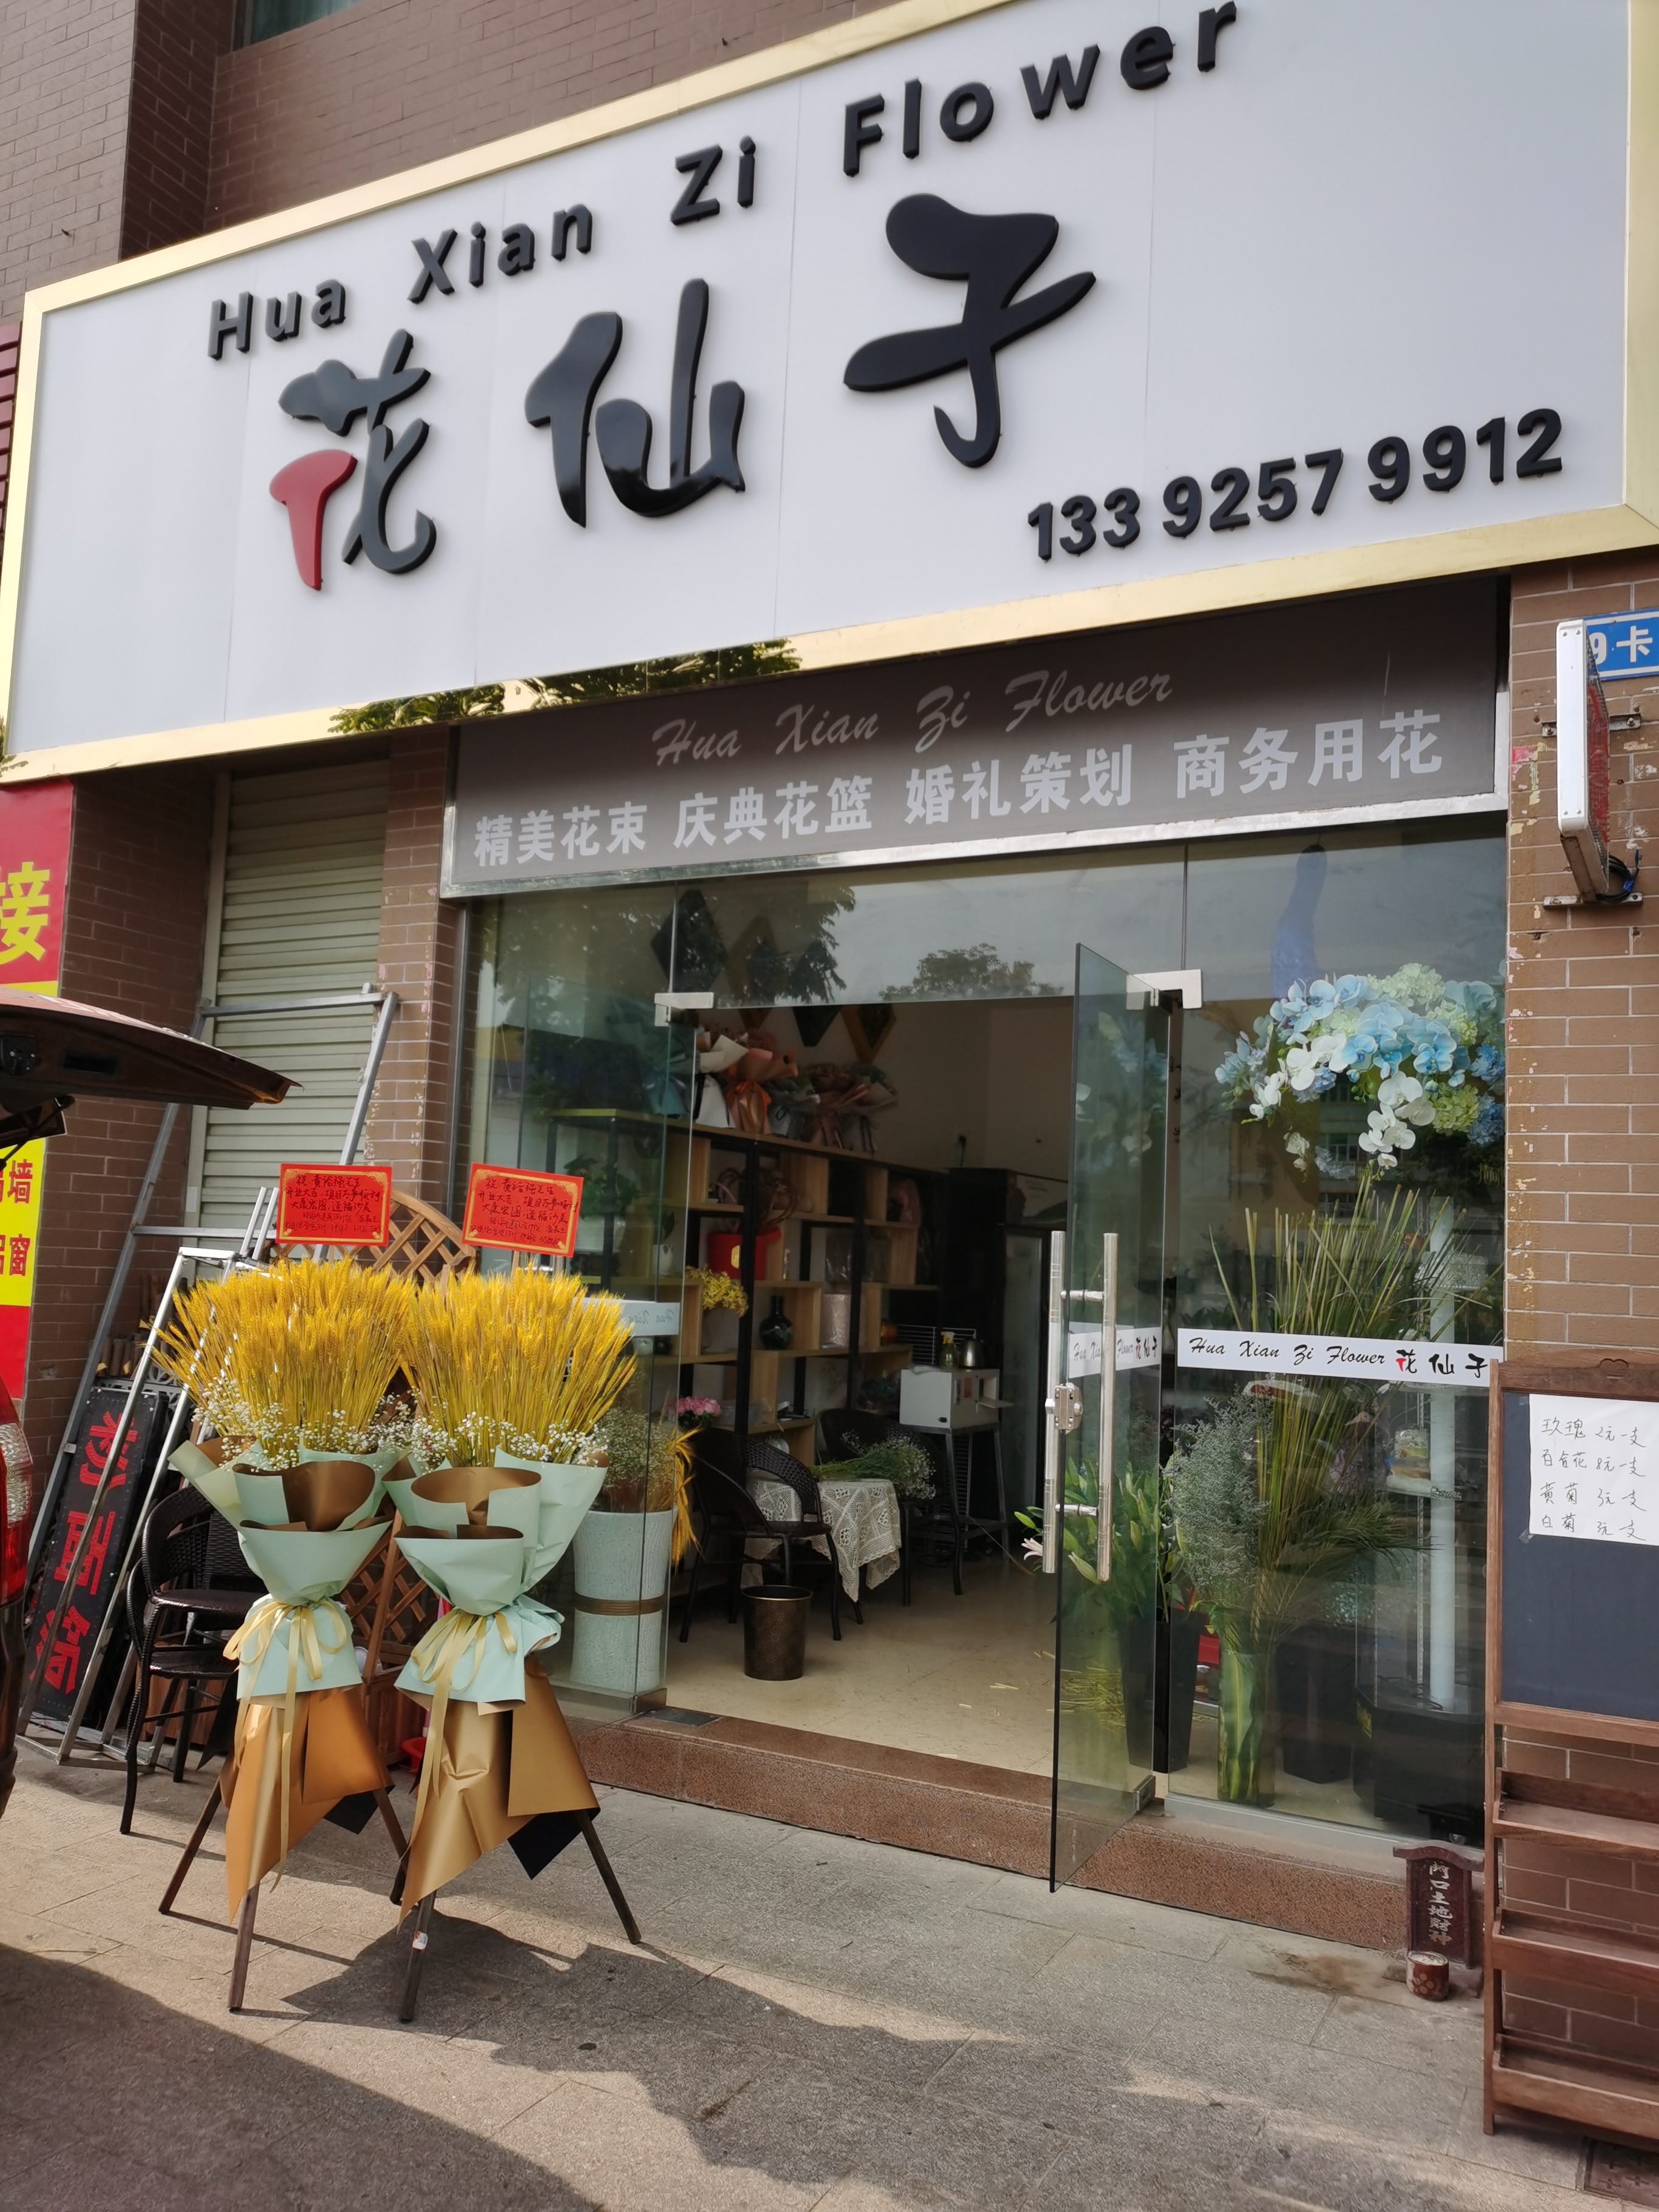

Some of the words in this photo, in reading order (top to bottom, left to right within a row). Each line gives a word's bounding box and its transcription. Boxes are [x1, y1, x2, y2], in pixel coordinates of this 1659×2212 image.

[207, 280, 346, 360] Hua
[408, 204, 593, 304] Xian
[670, 135, 757, 226] Zi
[843, 1, 1237, 177] Flower
[269, 192, 1096, 591] 花仙子
[1028, 487, 1141, 562] 133
[1162, 447, 1343, 539] 9257
[1367, 407, 1563, 503] 9912
[651, 719, 741, 766] Hua
[775, 704, 879, 755] Xian
[914, 685, 971, 754] Zi
[1004, 669, 1173, 732] Flower
[474, 801, 648, 867] 精美花束
[672, 775, 873, 849] 庆典花篮
[905, 744, 1133, 825] 婚礼策划
[1173, 708, 1443, 799] 商务用花
[1074, 1342, 1086, 1361] Hua
[1117, 1338, 1133, 1358] Flower
[1189, 1337, 1226, 1356] Hua
[1239, 1341, 1280, 1359] Xian
[1293, 1344, 1315, 1365] Zi
[1326, 1346, 1386, 1365] Flower
[1395, 1349, 1489, 1378] 花仙子
[1541, 1416, 1586, 1439] 玫瑰
[1541, 1449, 1587, 1469] 百合花
[1540, 1481, 1579, 1504] 黄菊
[1541, 1512, 1577, 1533] 白菊
